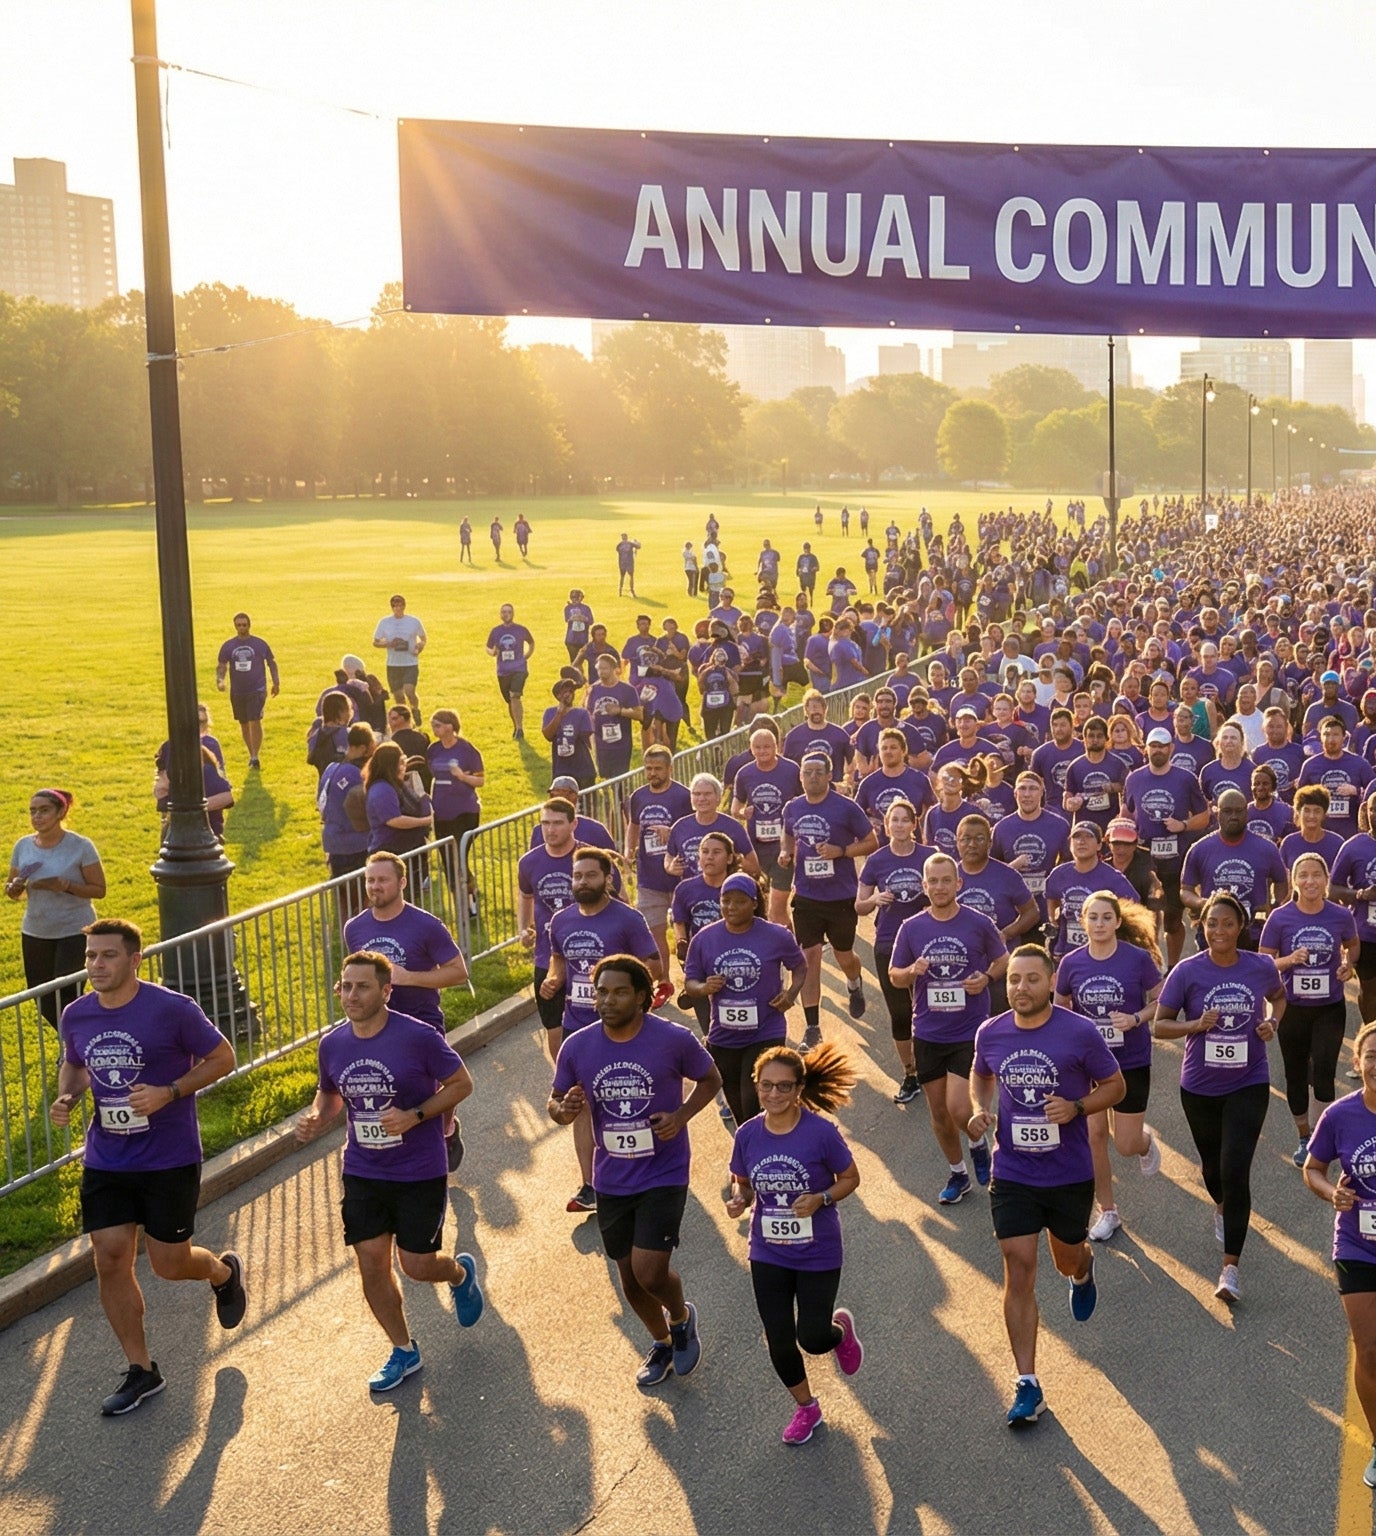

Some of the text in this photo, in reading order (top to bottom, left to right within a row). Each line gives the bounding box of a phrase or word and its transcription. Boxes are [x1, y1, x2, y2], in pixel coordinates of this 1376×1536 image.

[624, 183, 970, 280] ANNUAL
[726, 1009, 748, 1022] 58
[1215, 1045, 1235, 1058] 56
[1020, 1127, 1049, 1141] 558
[616, 1134, 637, 1149] 79
[771, 1220, 801, 1236] 550
